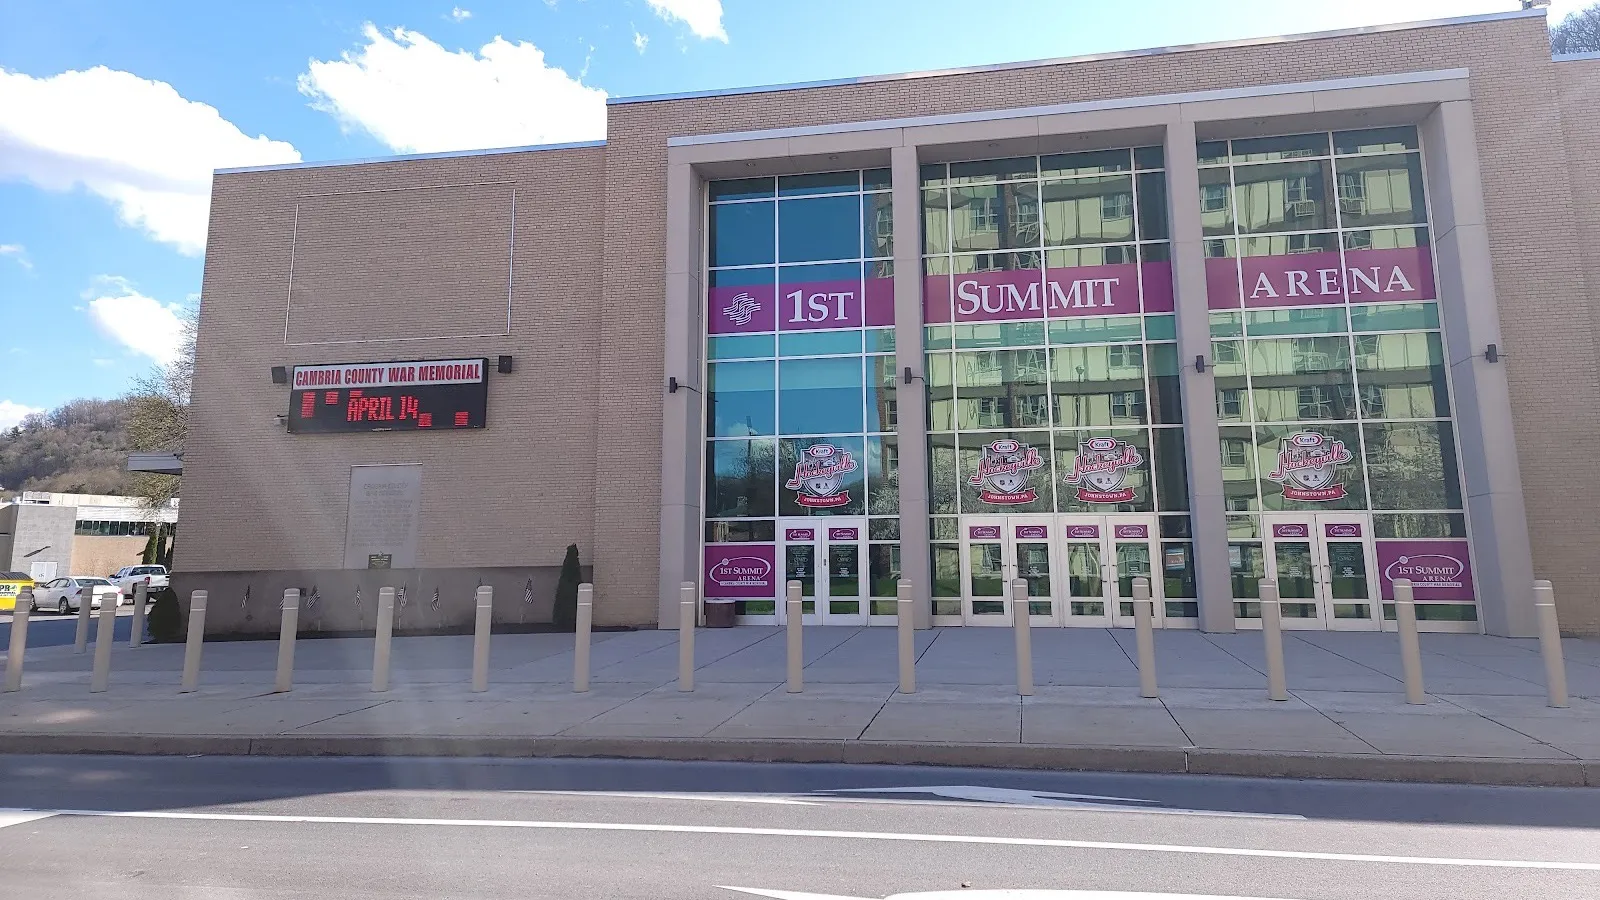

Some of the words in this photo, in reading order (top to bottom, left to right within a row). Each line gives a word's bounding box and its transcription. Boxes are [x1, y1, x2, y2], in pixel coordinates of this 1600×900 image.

[786, 289, 854, 323] 1ST
[957, 278, 1120, 315] SUMMIT
[1250, 265, 1415, 299] ARENA
[295, 369, 342, 387] CAMBRIA
[344, 367, 385, 385] COUNTY
[388, 366, 415, 383] WAR
[418, 363, 481, 381] MEMORIAL
[346, 396, 395, 422] APRIL
[399, 395, 419, 420] 14
[719, 567, 732, 575] 1ST
[733, 566, 764, 575] SUMMIT
[1397, 566, 1415, 575] 1ST
[1415, 565, 1455, 575] SUMMIT
